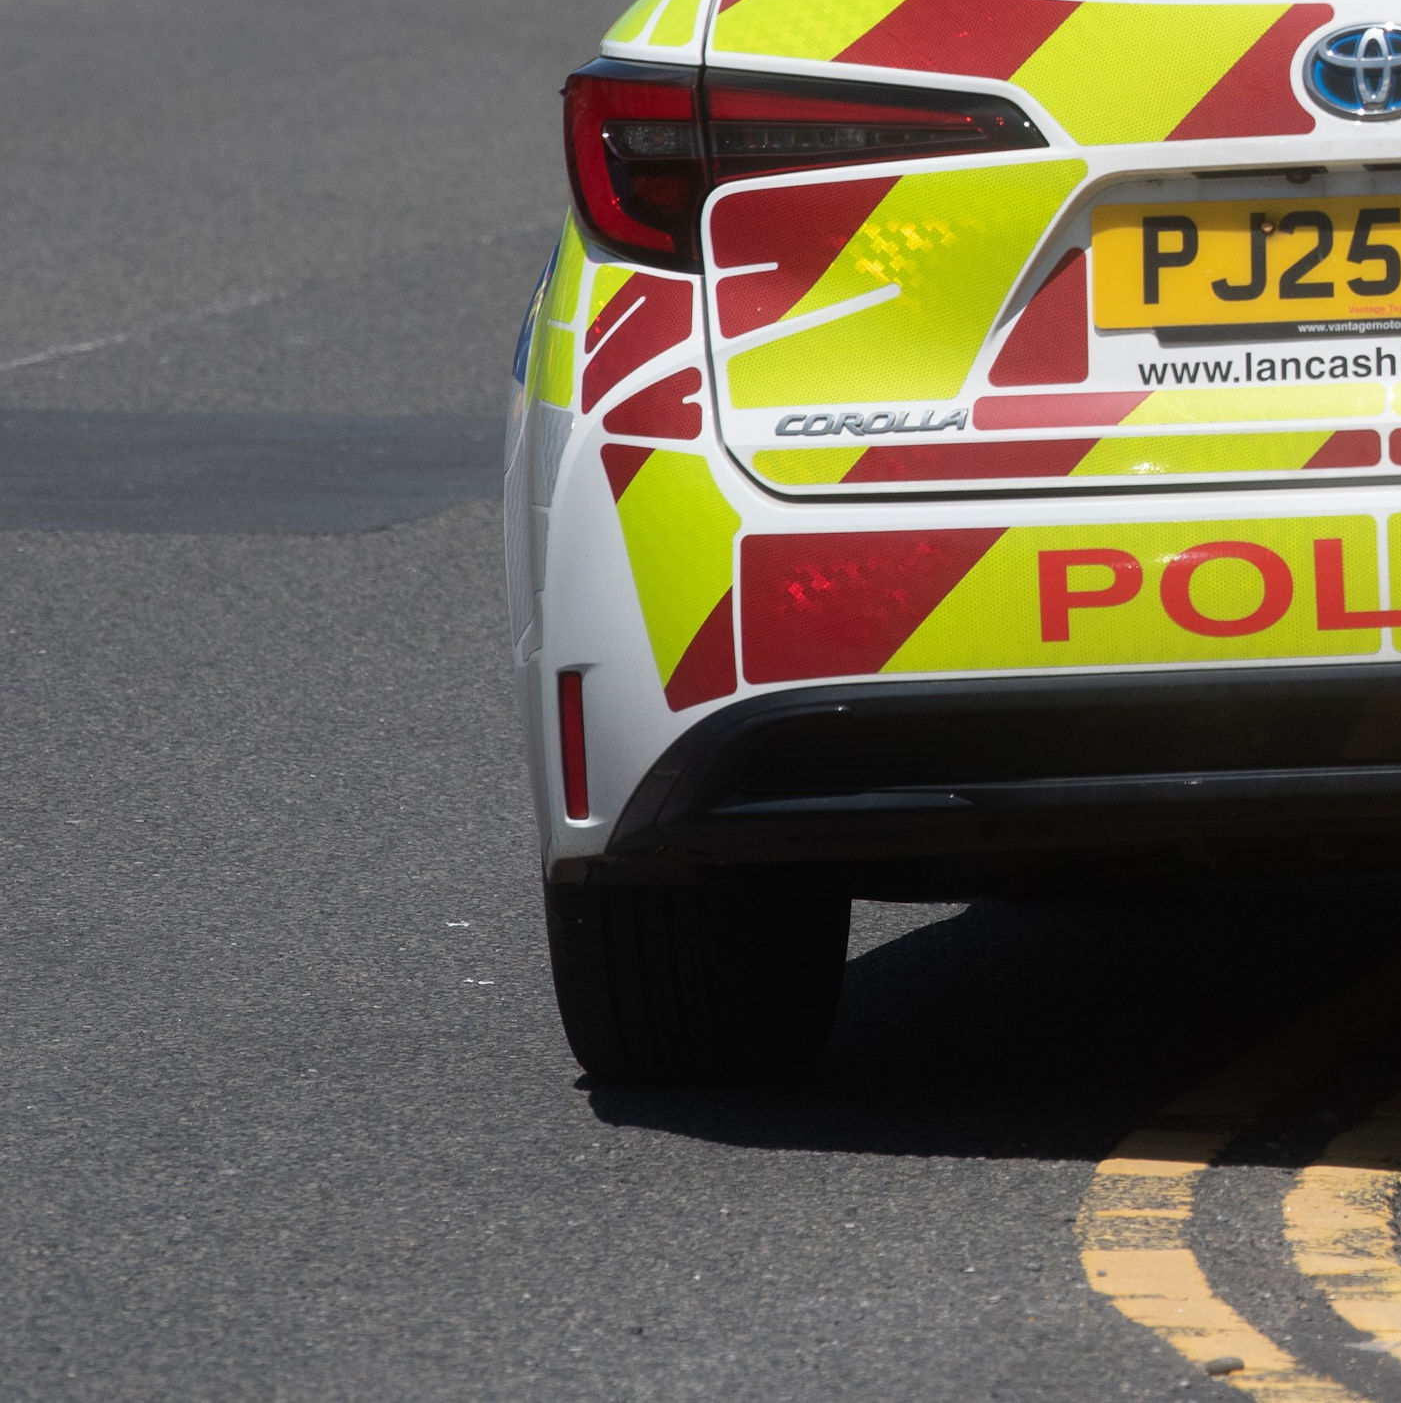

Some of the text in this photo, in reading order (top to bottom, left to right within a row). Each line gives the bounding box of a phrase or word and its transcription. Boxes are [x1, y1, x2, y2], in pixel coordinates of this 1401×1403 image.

[1142, 207, 1401, 305] PJ25
[1348, 305, 1385, 315] Vantage
[775, 408, 969, 437] COROLLA
